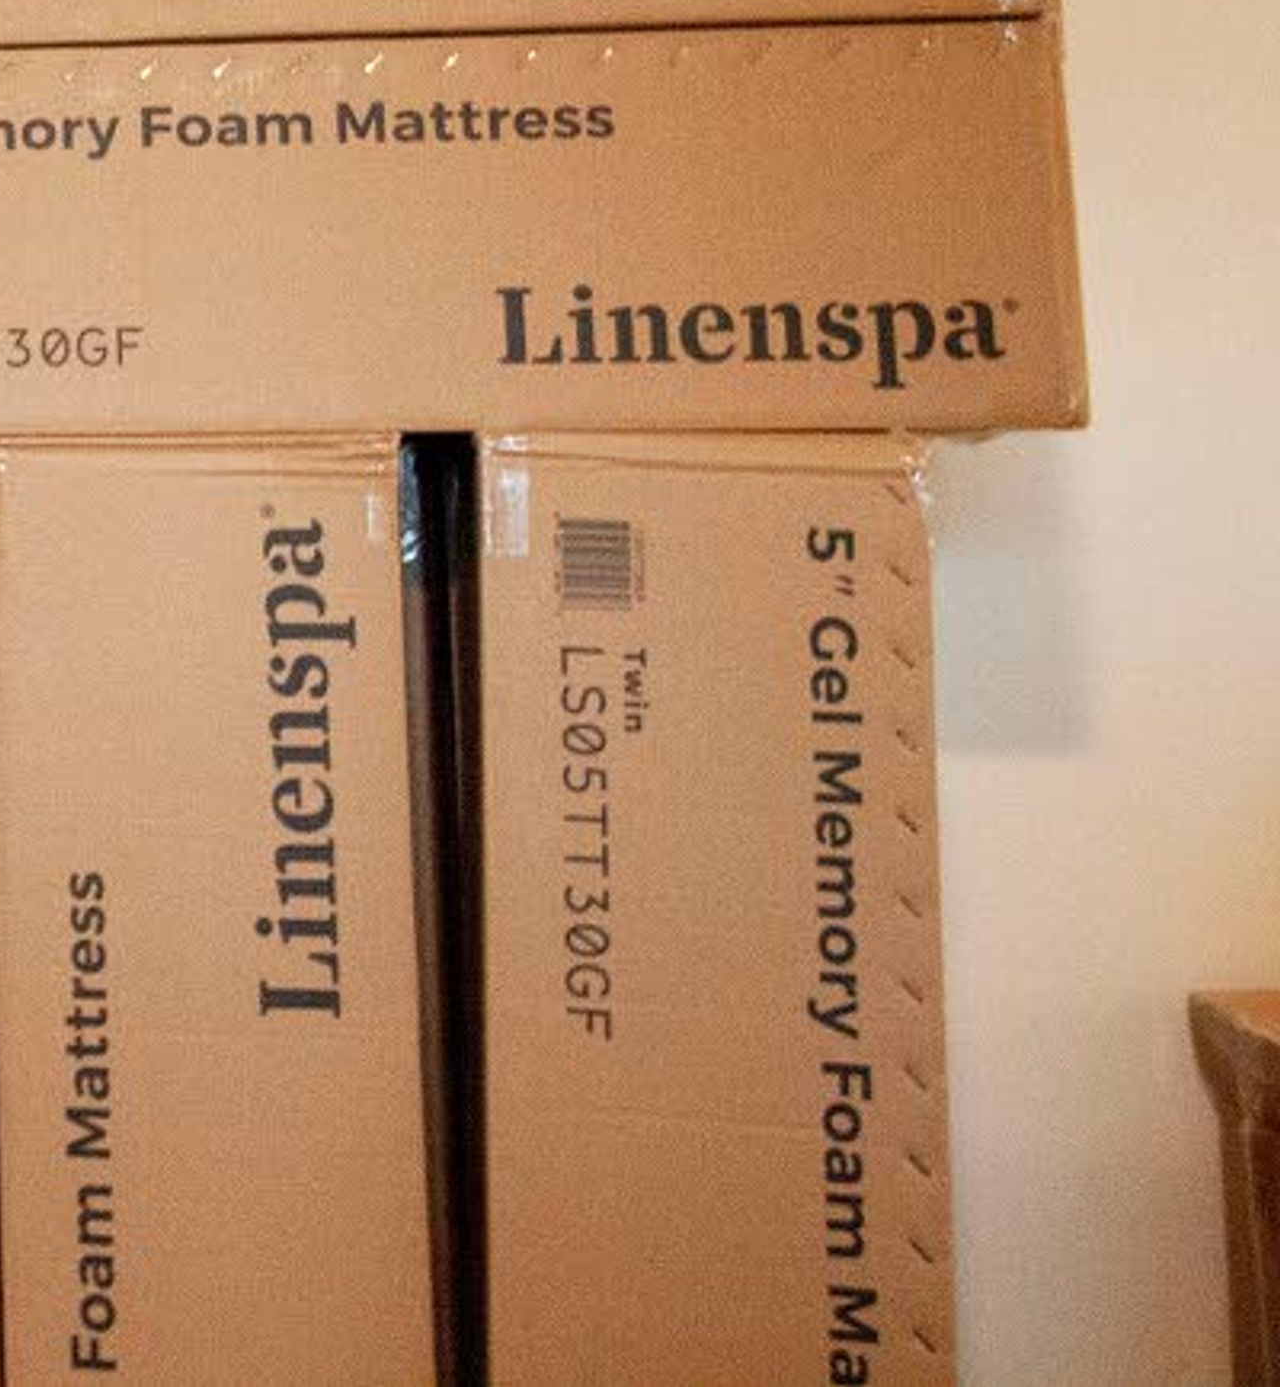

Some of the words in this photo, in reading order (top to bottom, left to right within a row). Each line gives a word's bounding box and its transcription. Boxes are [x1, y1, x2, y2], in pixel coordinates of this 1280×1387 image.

[141, 107, 313, 148] Foam
[337, 100, 615, 144] Mattress
[496, 285, 1007, 390] Linenspa
[624, 649, 647, 732] Twin
[810, 617, 863, 724] Gel
[255, 518, 357, 1020] Linenspa
[807, 751, 863, 1040] Memory
[65, 873, 112, 1160] Mattress
[821, 1061, 873, 1261] Foam
[69, 1184, 118, 1373] Foam
